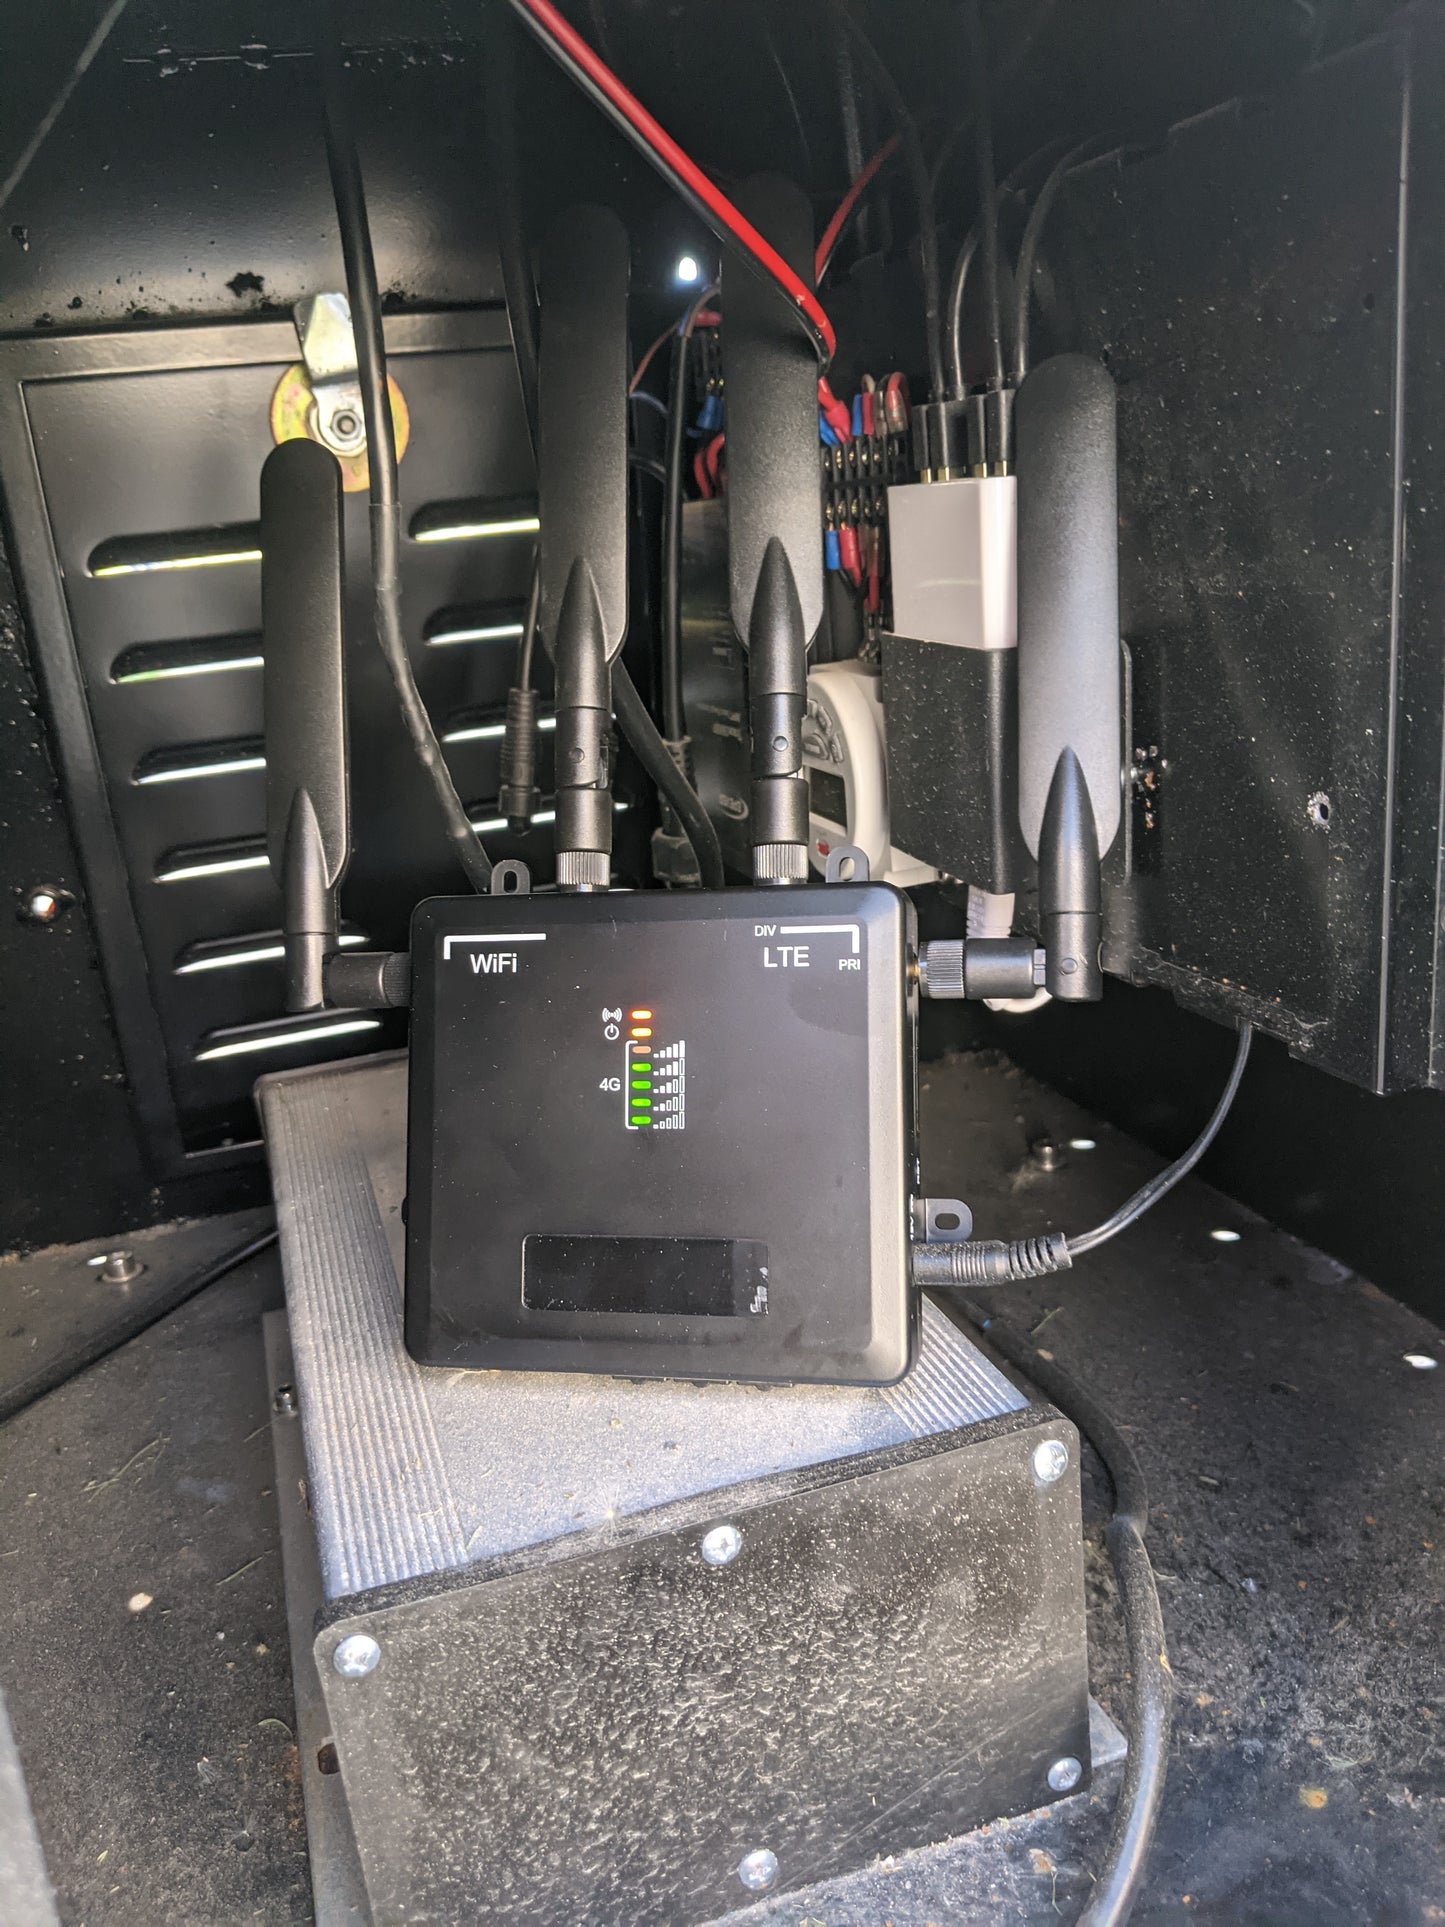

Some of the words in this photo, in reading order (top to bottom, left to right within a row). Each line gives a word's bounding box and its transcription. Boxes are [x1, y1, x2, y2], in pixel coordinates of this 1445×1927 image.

[754, 924, 777, 937] DIV
[469, 952, 518, 974] WiFi
[763, 945, 811, 968] LTE
[838, 958, 861, 971] PRI
[598, 1077, 621, 1092] 4G
